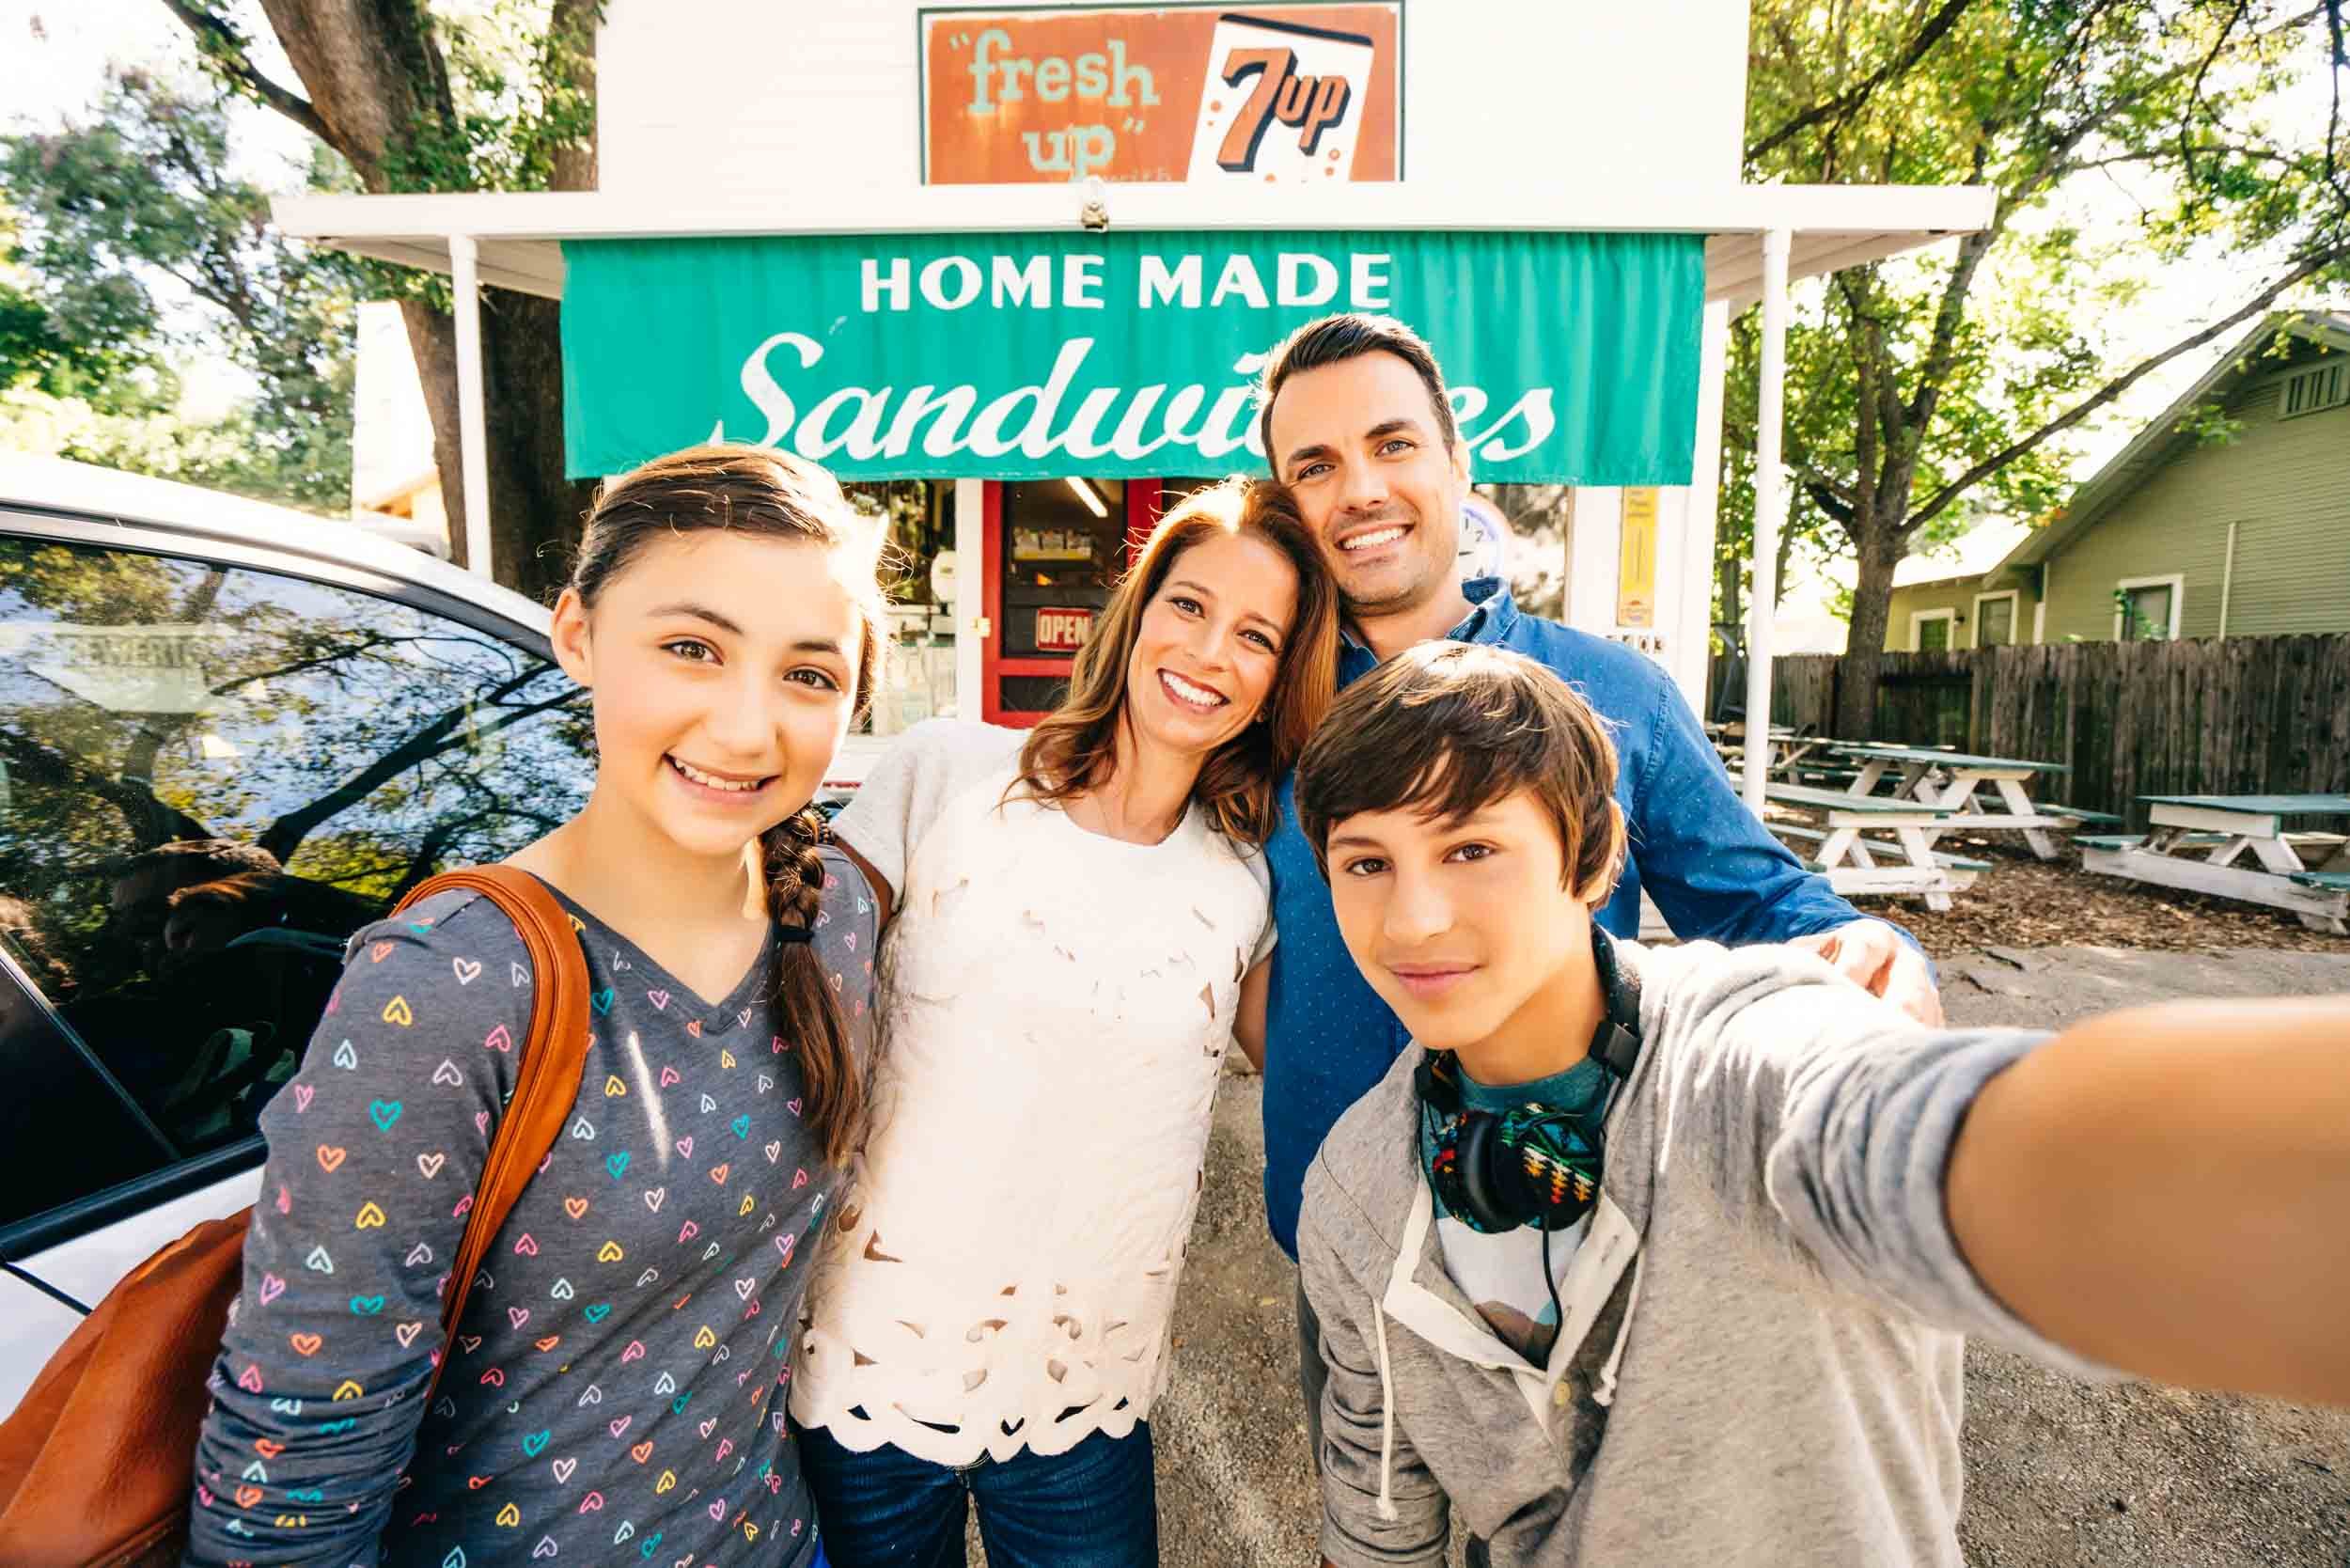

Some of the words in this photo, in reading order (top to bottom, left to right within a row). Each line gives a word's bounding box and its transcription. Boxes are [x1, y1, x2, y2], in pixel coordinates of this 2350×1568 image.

[1216, 47, 1351, 172] 7up
[861, 255, 1105, 311] HOME
[1138, 253, 1391, 308] MADE
[707, 332, 1556, 462] Sandwies
[1039, 615, 1093, 646] OPEN
